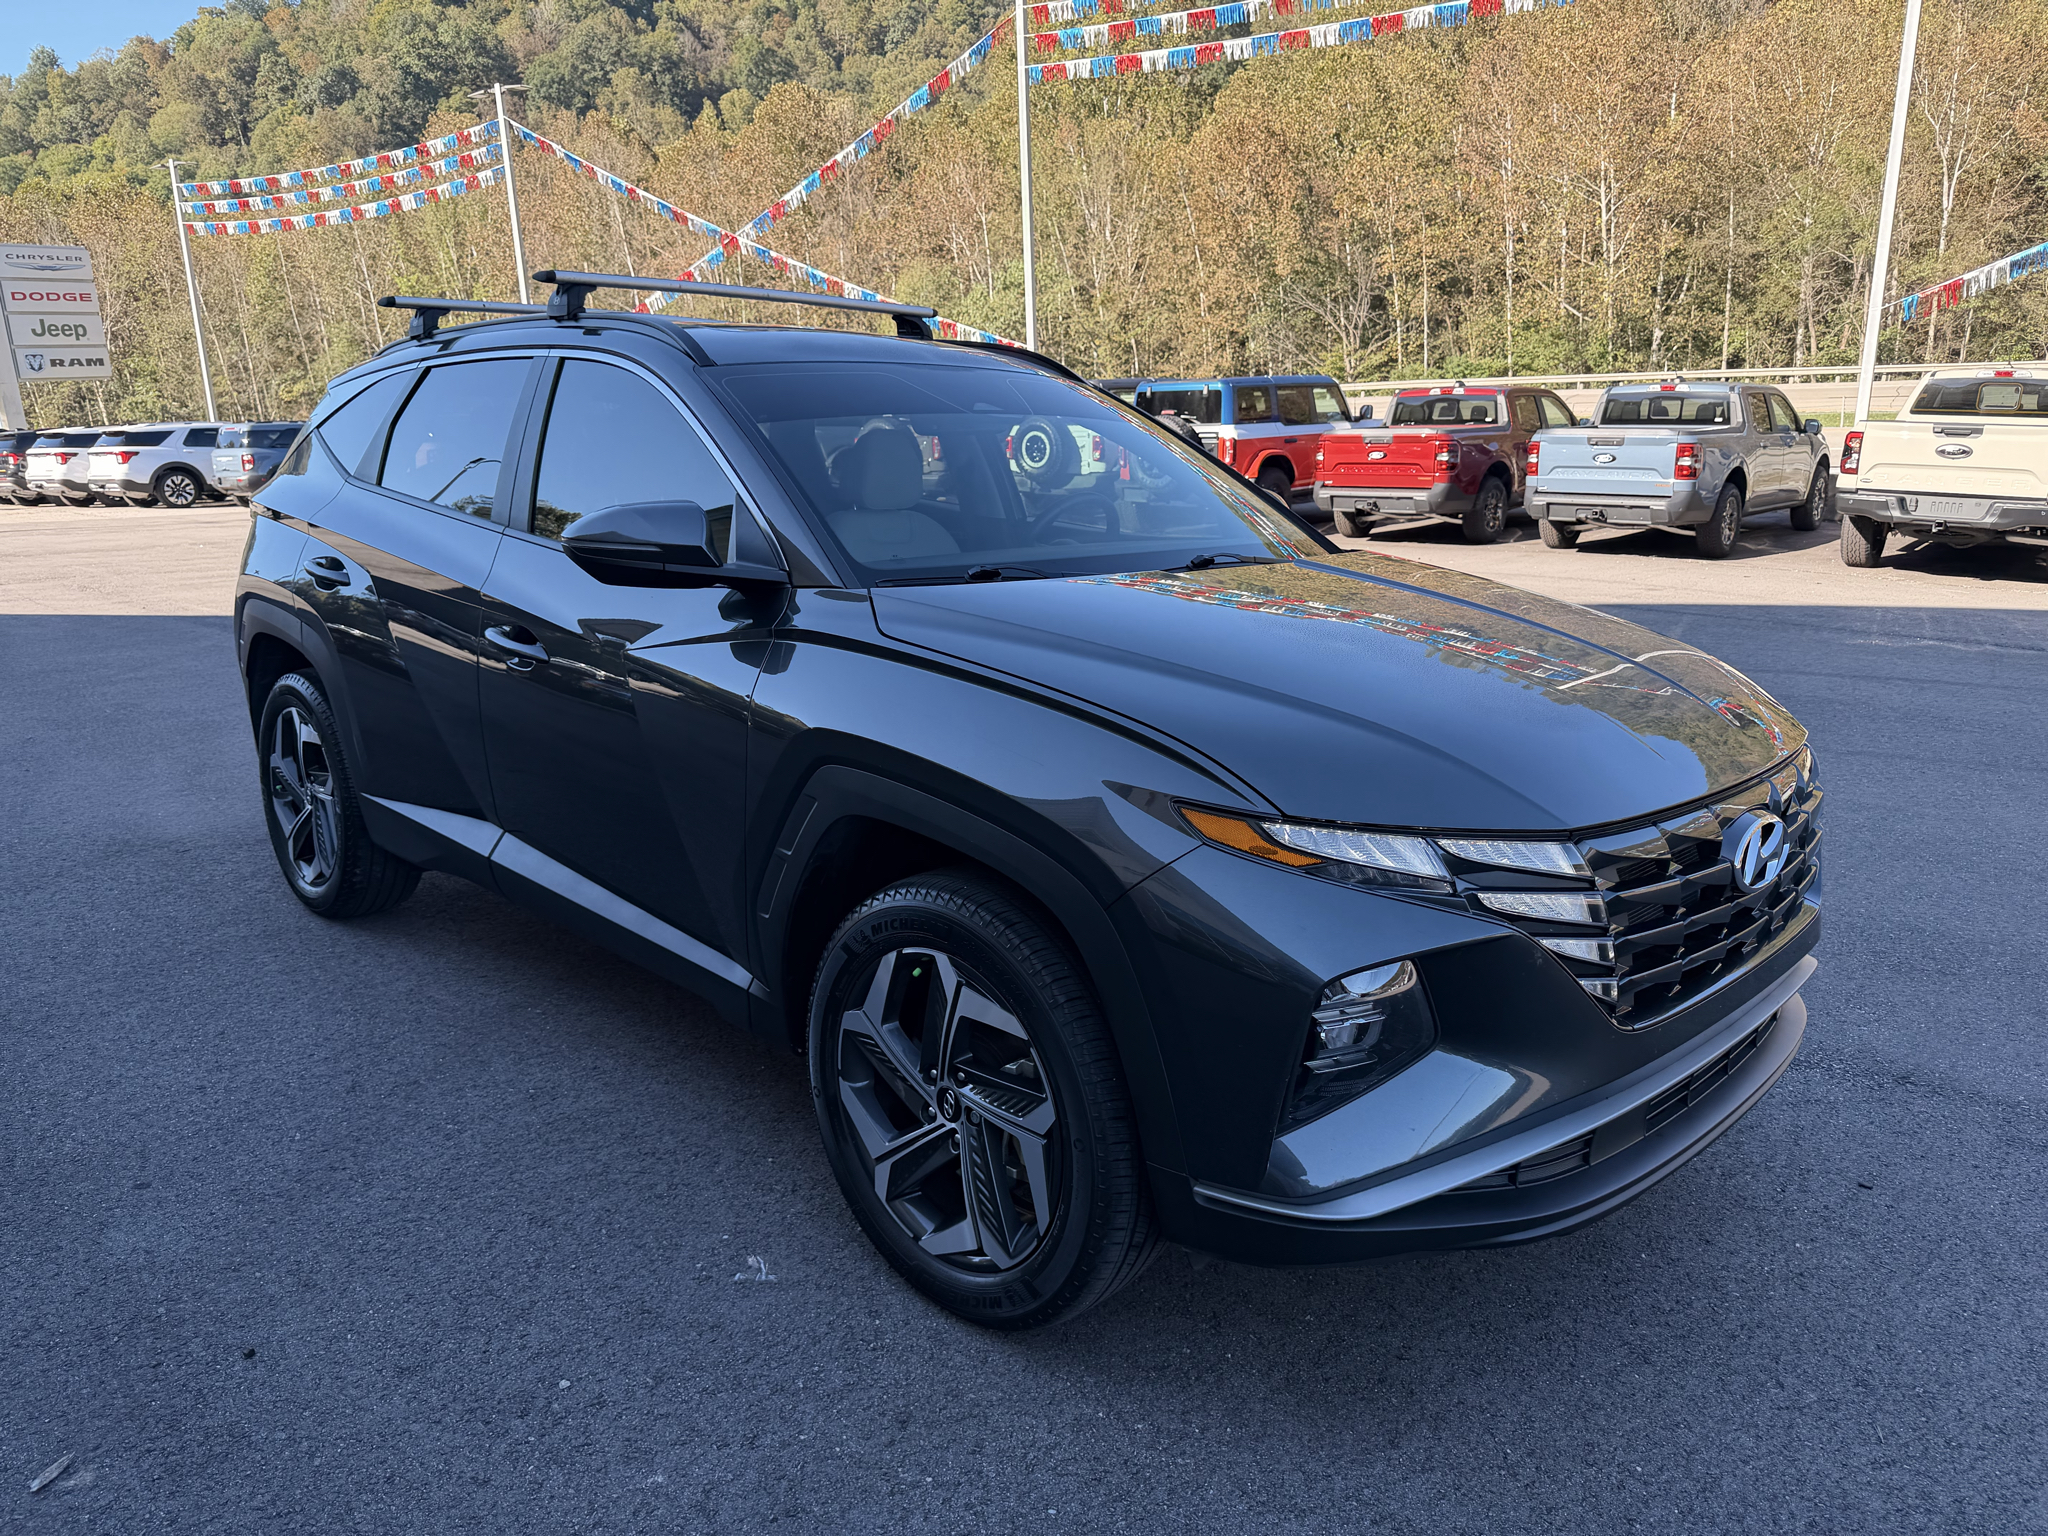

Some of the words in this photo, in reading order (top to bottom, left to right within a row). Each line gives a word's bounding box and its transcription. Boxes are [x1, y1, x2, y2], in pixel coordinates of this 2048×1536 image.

[5, 253, 83, 262] CHRYSLER
[10, 291, 93, 302] DODGE
[30, 318, 88, 341] Jeep
[49, 357, 105, 368] RAM
[1873, 472, 2032, 491] RANGER
